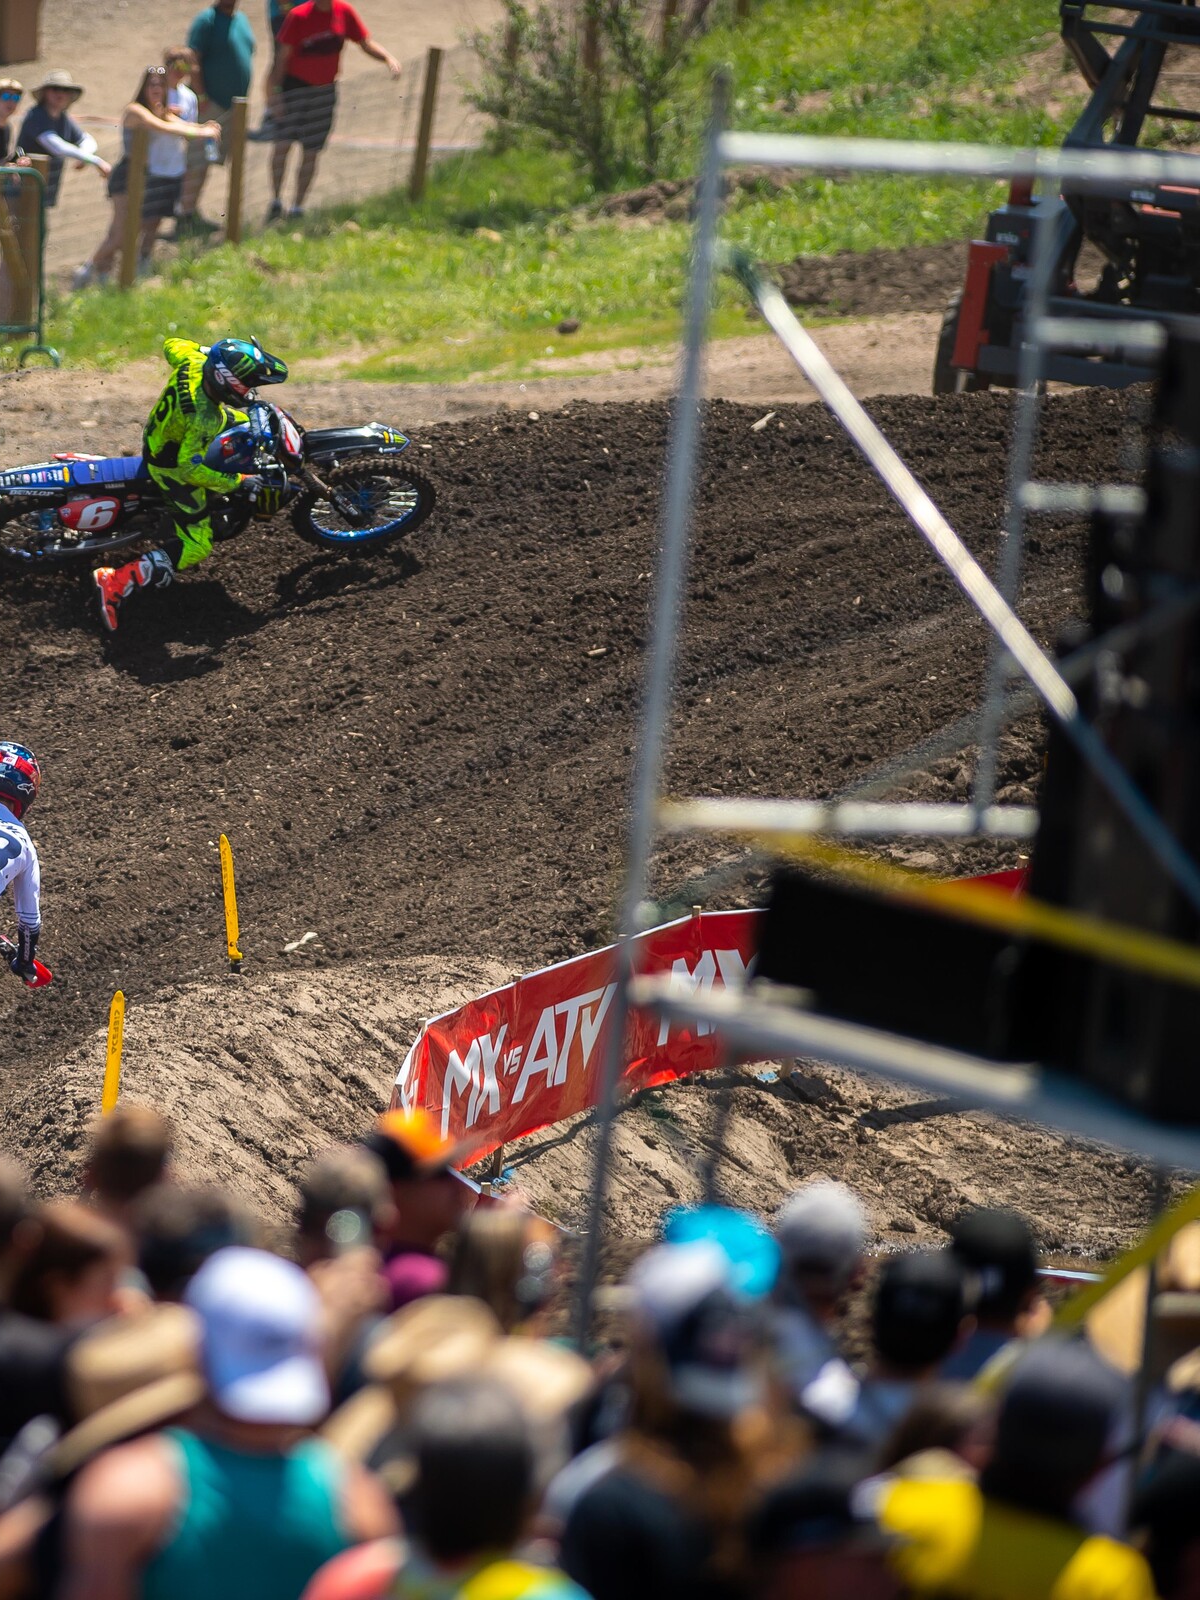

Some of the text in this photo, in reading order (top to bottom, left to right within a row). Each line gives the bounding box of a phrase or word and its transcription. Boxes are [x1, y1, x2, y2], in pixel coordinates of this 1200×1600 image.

[9, 489, 55, 497] DUNLOP
[76, 500, 116, 529] 6
[440, 1023, 508, 1143] MX
[511, 982, 618, 1104] ATV
